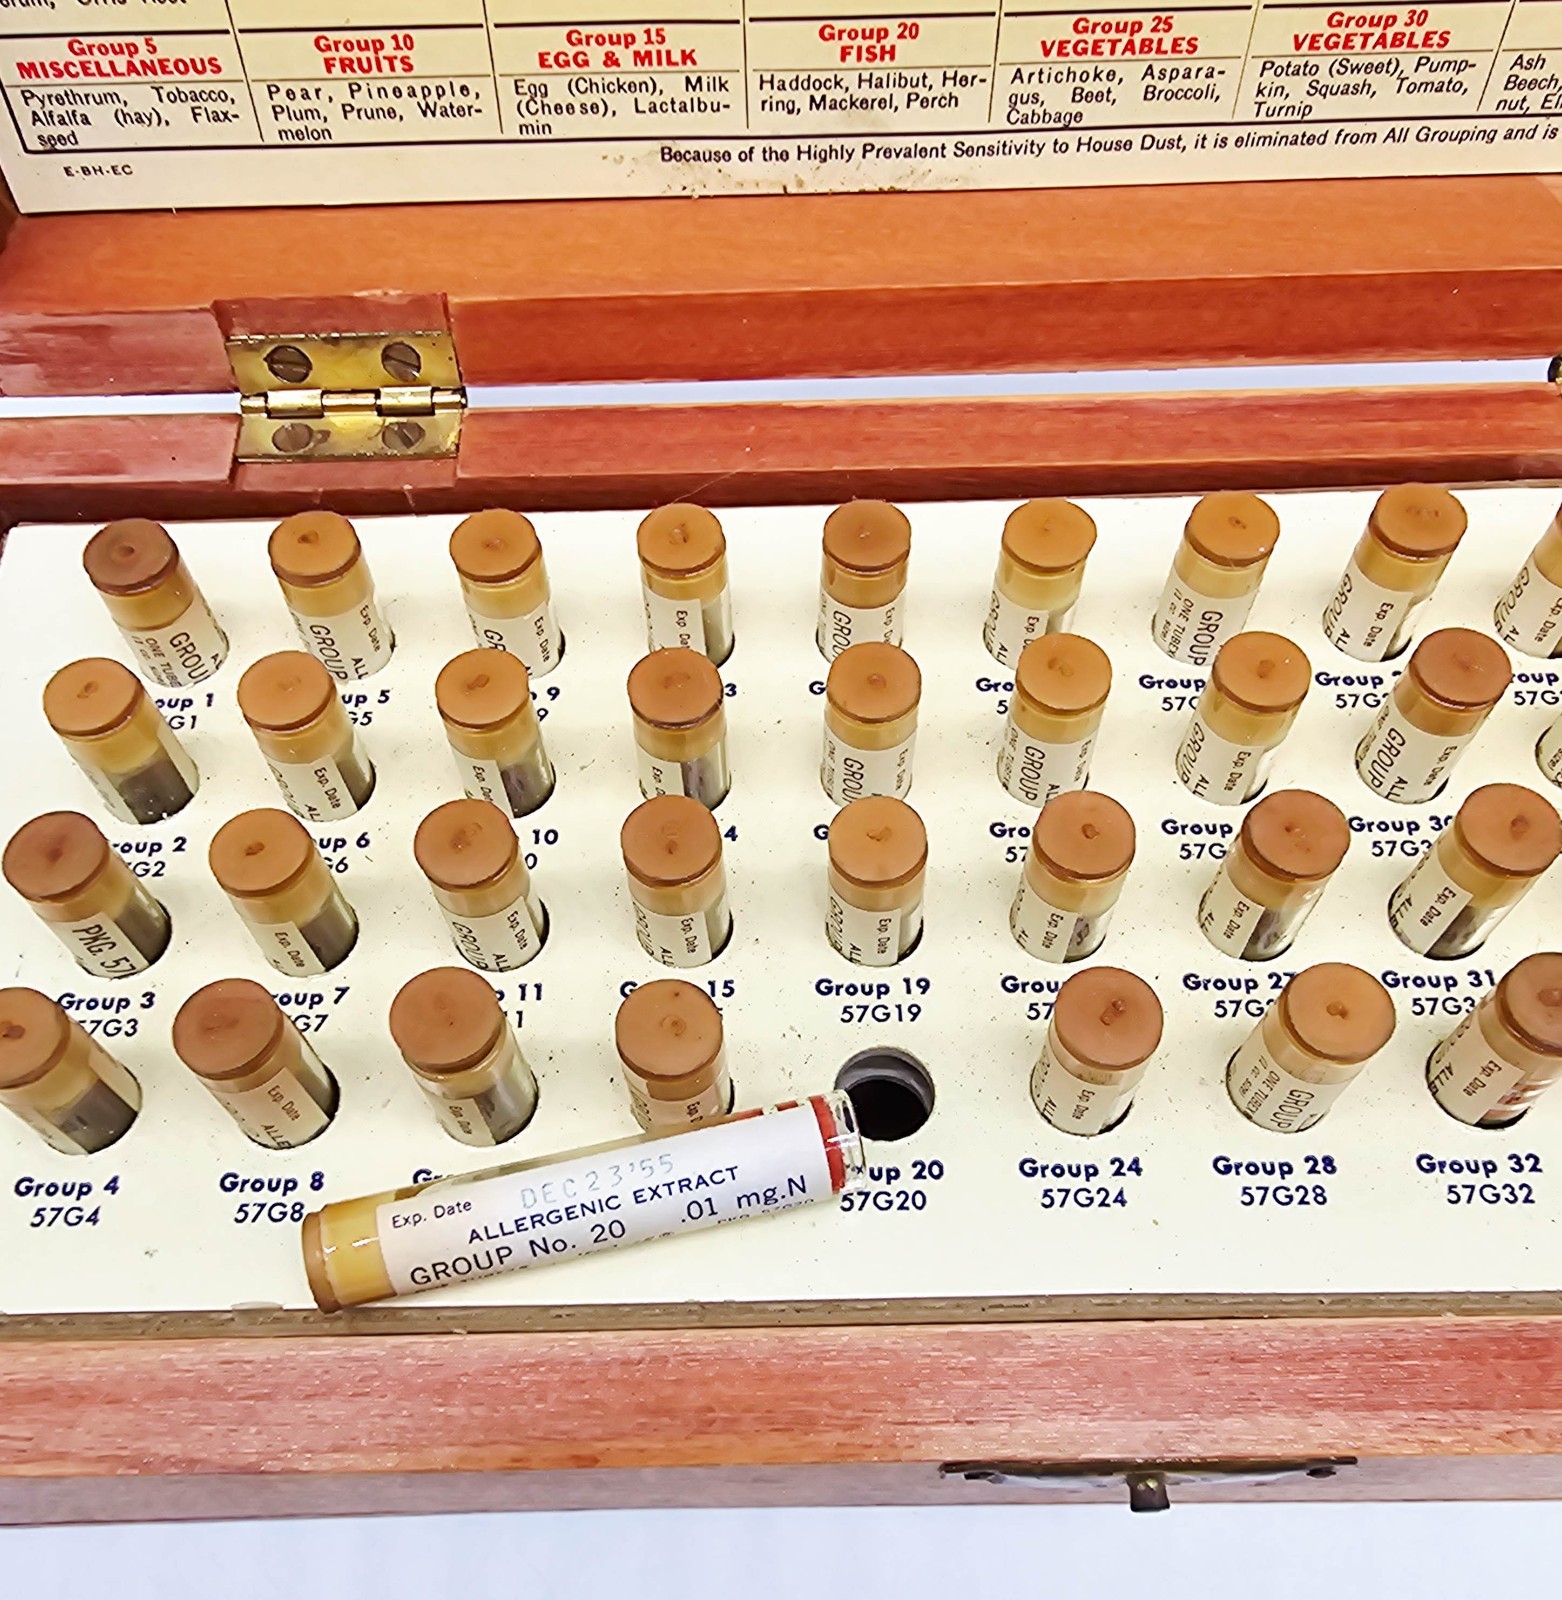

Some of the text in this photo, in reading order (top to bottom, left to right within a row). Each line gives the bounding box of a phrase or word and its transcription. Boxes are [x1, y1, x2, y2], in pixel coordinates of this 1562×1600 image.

[1072, 15, 1174, 38] Group 25
[1326, 9, 1429, 32] Group 30
[313, 33, 415, 54] Group 10
[565, 27, 666, 50] Group 15
[818, 21, 920, 44] Group 20
[1293, 30, 1450, 54] VEGETABLES
[67, 37, 158, 59] Group 5
[538, 48, 698, 69] EGG & MILK
[840, 44, 896, 63] FISH
[1040, 36, 1199, 58] VEGETABLES
[15, 56, 223, 80] MISCELLANEOUS
[323, 56, 414, 75] FRUITS
[1259, 55, 1477, 79] Potato (Sweet), Pump-
[1509, 53, 1546, 71] Ash
[759, 69, 987, 94] Haddock, Halibut, Her-
[1010, 63, 1226, 86] Artichoke, Aspara-
[1503, 73, 1560, 92] Beech,
[20, 85, 235, 110] Pyrethrum, Tobacco,
[266, 80, 480, 104] Pear, Pineapple,
[513, 75, 729, 98] Egg (Chicken), Milk
[1007, 83, 1220, 109] gus, Beet, Broccoli,
[1255, 76, 1468, 101] kin, Squash, Tomato,
[271, 102, 483, 124] Plum, Prune, Water-
[516, 96, 731, 119] (Cheese), Lactalbu-
[761, 91, 959, 116] ring, Mackerel, Perch
[1254, 100, 1313, 118] Turnip
[1495, 95, 1531, 114] nut,
[31, 105, 240, 128] Alfalfa (hay), Flax-
[518, 119, 552, 136] min
[1006, 108, 1084, 126] Cabbage
[37, 129, 79, 147] seed
[277, 124, 333, 141] melon
[660, 123, 1559, 164] Because of the Highly Prevalent Sensitivity to House Dust, it is eliminated from All Grouping and is
[1178, 598, 1194, 621] ONE
[360, 605, 381, 652] Exp. Date
[1363, 602, 1393, 647] Exp. Date
[1534, 617, 1556, 642] Date
[534, 616, 551, 662] Exp. Date
[1188, 610, 1223, 666] GROUP
[309, 624, 348, 682] GROUP
[1138, 674, 1207, 693] Group
[1314, 671, 1384, 690] Group
[206, 692, 214, 708] 1
[377, 689, 391, 704] 5
[546, 686, 561, 702] 9
[1181, 722, 1205, 784] GROUP
[1368, 728, 1406, 788] GROUP
[1019, 746, 1045, 801] GROUP
[1224, 751, 1251, 791] Exp. Date
[314, 767, 327, 789] Exp.
[326, 788, 341, 809] Date
[1161, 818, 1233, 839] Group
[1349, 815, 1421, 833] Group
[172, 836, 187, 853] 2
[355, 831, 371, 849] 6
[532, 828, 559, 846] 10
[1420, 886, 1457, 926] Exp. Date
[506, 911, 529, 951] Exp. Date
[1223, 901, 1250, 939] Exp. Date
[72, 924, 117, 956] PKG.
[681, 917, 698, 954] Exp. Date
[876, 917, 892, 955] Exp. Date
[274, 931, 306, 968] Exp. Date
[518, 982, 543, 1002] 11
[707, 979, 735, 998] 15
[814, 977, 931, 1000] Group 19
[1182, 973, 1259, 990] Group
[1381, 969, 1496, 993] Group 31
[58, 991, 156, 1010] Group 3
[333, 986, 350, 1005] 7
[840, 1003, 922, 1024] 57G19
[1262, 1070, 1280, 1091] ONE
[1463, 1060, 1502, 1097] Exp. Date
[267, 1085, 301, 1121] Exp. Date
[1270, 1089, 1315, 1128] GROUP
[911, 1159, 944, 1181] 20
[1018, 1156, 1143, 1183] Group 24
[1212, 1154, 1337, 1181] Group 28
[1415, 1152, 1543, 1179] Group 32
[14, 1175, 120, 1202] Group 4
[219, 1171, 325, 1197] Group 8
[1240, 1184, 1328, 1207] 57G28
[1447, 1182, 1536, 1205] 57G32
[468, 1195, 622, 1244] ALLERGENIC
[632, 1166, 739, 1205] EXTRACT
[839, 1189, 927, 1212] 57G20
[1040, 1187, 1128, 1209] 57G24
[30, 1206, 101, 1228] 57G4
[234, 1203, 304, 1224] 57G8
[393, 1209, 427, 1228] Exp.
[434, 1200, 472, 1219] Date
[410, 1246, 513, 1285] GROUP
[529, 1236, 577, 1258] No.
[590, 1219, 627, 1244] 20
[681, 1197, 720, 1224] .01
[736, 1174, 807, 1206] mg.N
